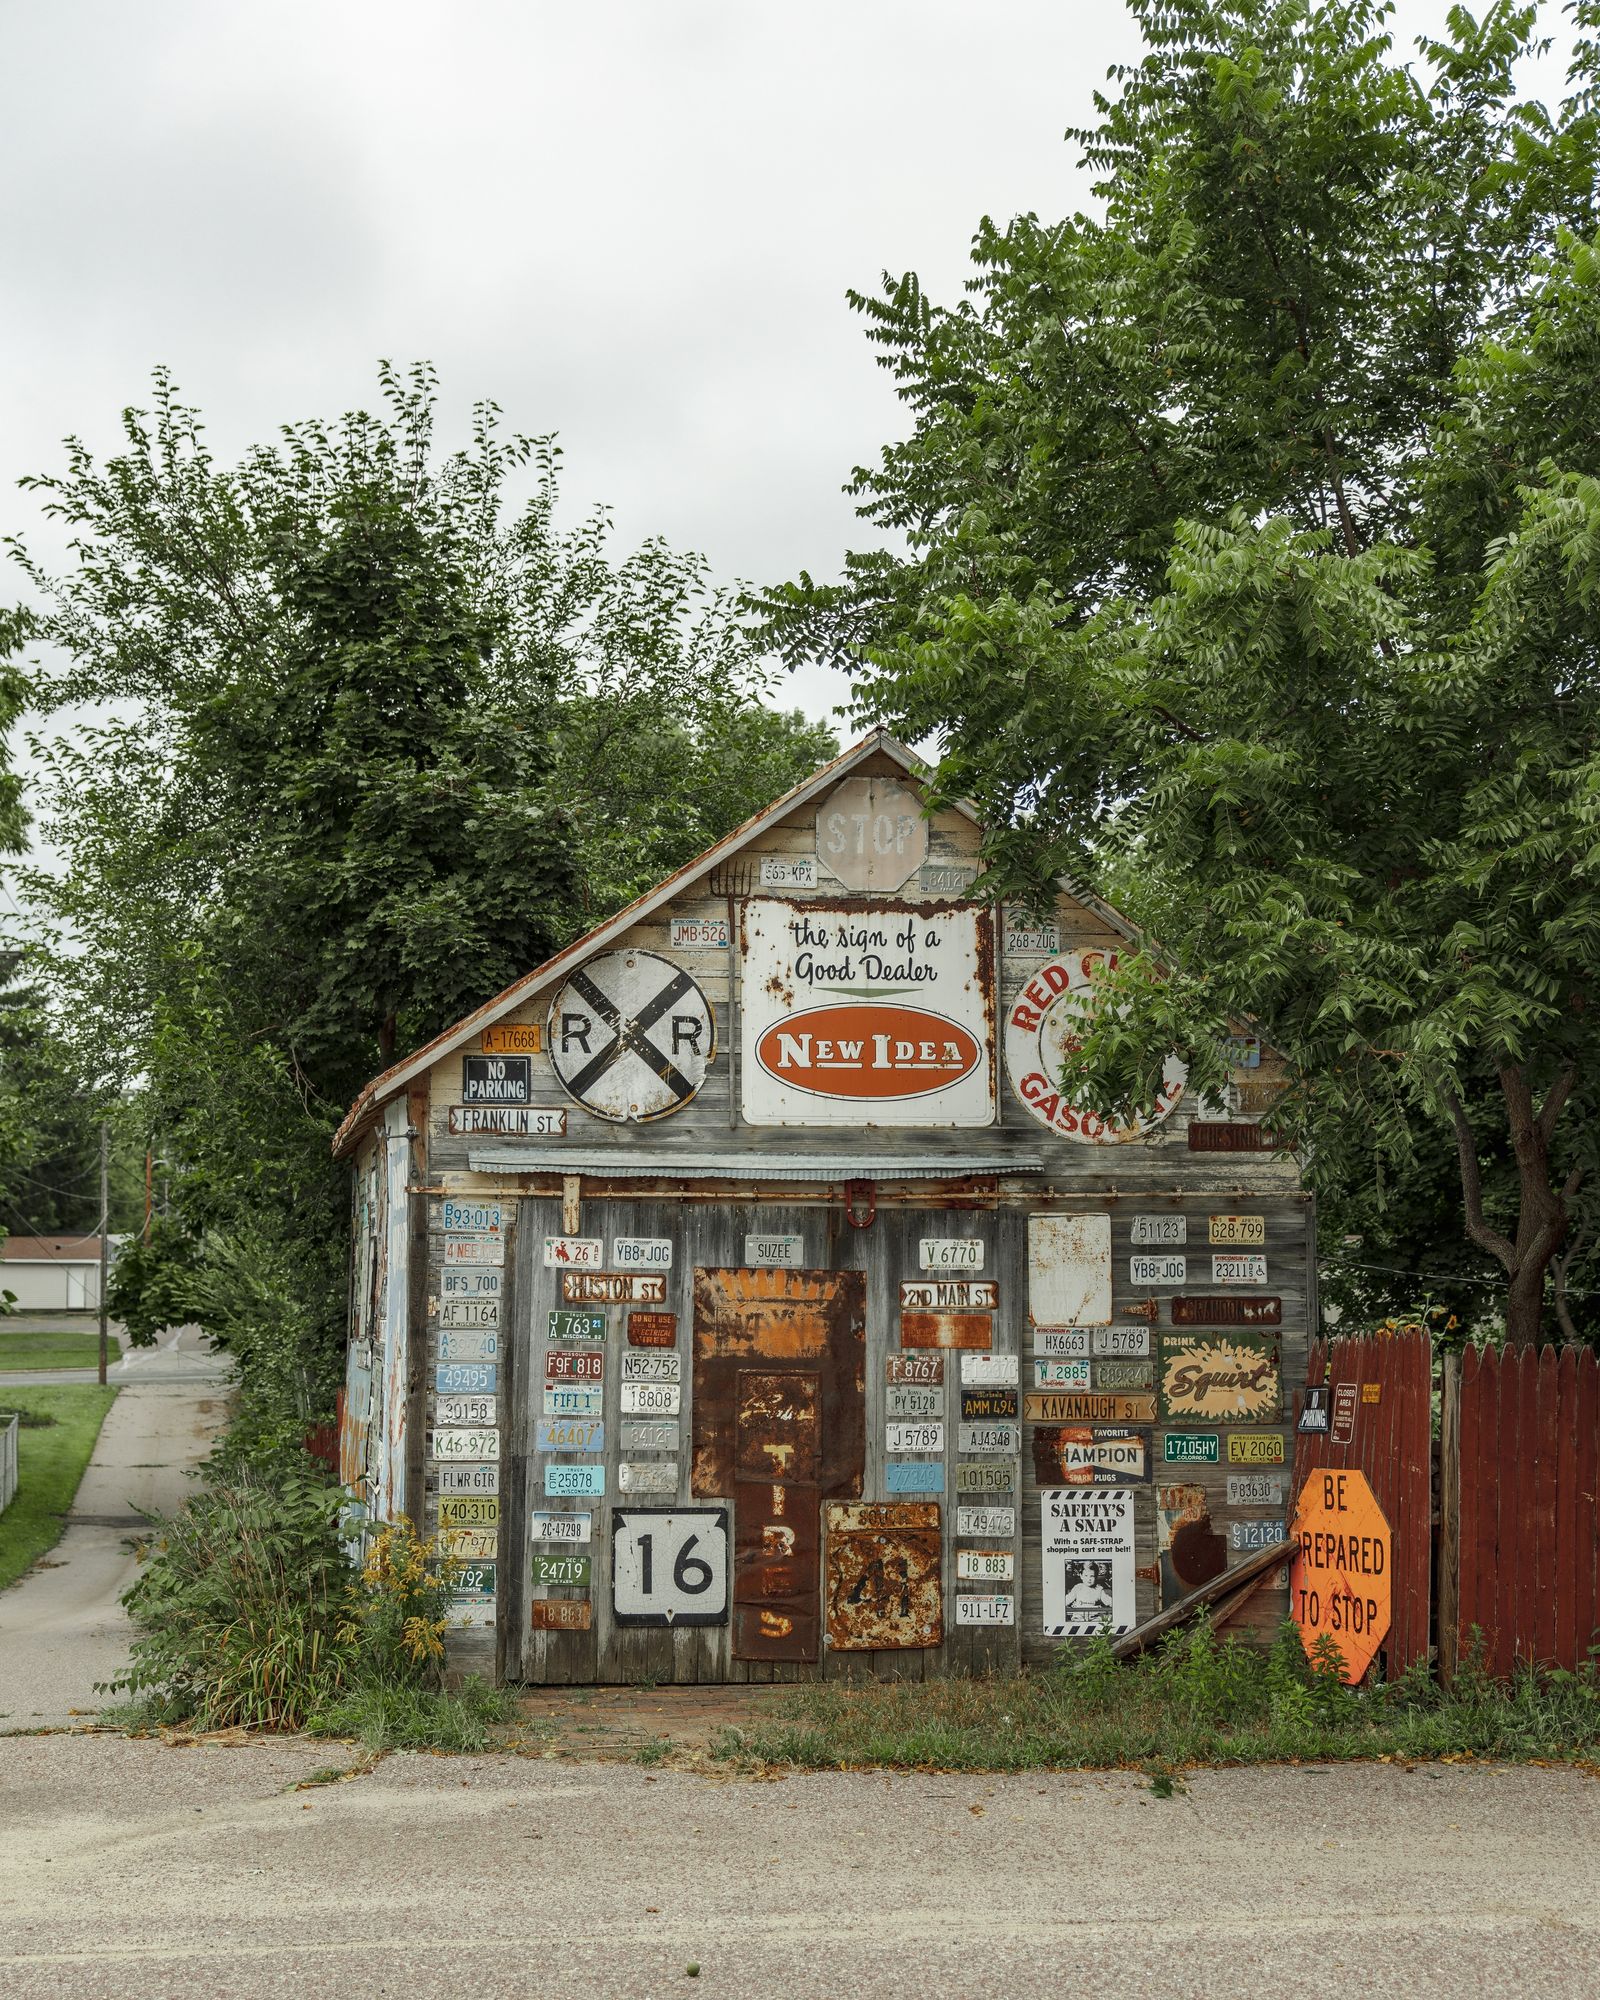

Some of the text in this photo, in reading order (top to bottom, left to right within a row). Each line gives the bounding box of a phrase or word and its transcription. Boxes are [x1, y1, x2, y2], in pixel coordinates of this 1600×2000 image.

[827, 813, 916, 854] STOP
[792, 918, 940, 953] the sign of a
[1010, 933, 1056, 949] 268-ZUG
[795, 953, 937, 985] Good Dealer
[1011, 965, 1070, 1033] RED
[486, 1032, 535, 1048] A-17668
[562, 1014, 591, 1054] R
[671, 1016, 702, 1055] R
[488, 1062, 505, 1078] NO
[469, 1080, 524, 1098] PARKING
[463, 1110, 553, 1132] FRANKLIN ST
[1139, 1223, 1179, 1238] 51123
[575, 1247, 588, 1260] 26
[617, 1245, 639, 1260] YB8
[758, 1243, 790, 1258] SUZEE
[928, 1247, 976, 1263] V 6770
[1133, 1263, 1156, 1277] YB8
[1216, 1264, 1247, 1277] 23211
[446, 1276, 498, 1291] BFS 700
[572, 1277, 657, 1299] HUSTON ST
[908, 1285, 990, 1306] 2ND MAIN ST
[443, 1305, 497, 1322] AF 1164
[633, 1315, 642, 1323] DO
[644, 1315, 656, 1323] NOT
[565, 1318, 590, 1334] 763
[1045, 1336, 1084, 1350] HX6663
[1100, 1334, 1144, 1349] J 5789
[1164, 1337, 1196, 1346] DRINK
[548, 1357, 601, 1374] F9F 818
[892, 1362, 938, 1377] F 8767
[1057, 1366, 1088, 1379] 2885
[445, 1371, 487, 1386] 49495
[1169, 1362, 1274, 1401] Squirt
[554, 1393, 591, 1408] FIFI 1
[632, 1391, 672, 1408] 18808
[1337, 1389, 1355, 1397] CLOSED
[895, 1396, 907, 1409] PY
[965, 1400, 1015, 1414] AMM 494
[1042, 1398, 1138, 1419] KAVANAUGH ST
[446, 1403, 487, 1419] 30158
[1301, 1409, 1326, 1427] PARKING
[547, 1428, 595, 1445] 46407
[893, 1431, 901, 1446] J
[971, 1431, 1010, 1446] AJ4348
[1094, 1429, 1129, 1437] FAVORITE
[1056, 1448, 1137, 1463] HAMPION
[1168, 1441, 1216, 1455] 17105HY
[1231, 1442, 1281, 1457] EV 2060
[443, 1473, 494, 1487] FLWR GIR
[558, 1473, 592, 1488] 25878
[962, 1470, 1010, 1487] 101505
[1094, 1474, 1117, 1482] PLUGS
[1240, 1483, 1271, 1498] 83630
[1324, 1475, 1347, 1512] BE
[965, 1514, 1012, 1531] T49473
[1060, 1519, 1117, 1533] A SNAP
[1244, 1528, 1283, 1543] 12120
[1046, 1545, 1079, 1554] shopping
[1115, 1545, 1131, 1553] belt!
[1292, 1531, 1384, 1575] REPARED
[540, 1563, 583, 1579] 24719
[637, 1533, 713, 1595] 16
[967, 1558, 1006, 1573] 18 883
[962, 1603, 1008, 1618] 911-LFZ
[1299, 1590, 1377, 1636] TO STOP
